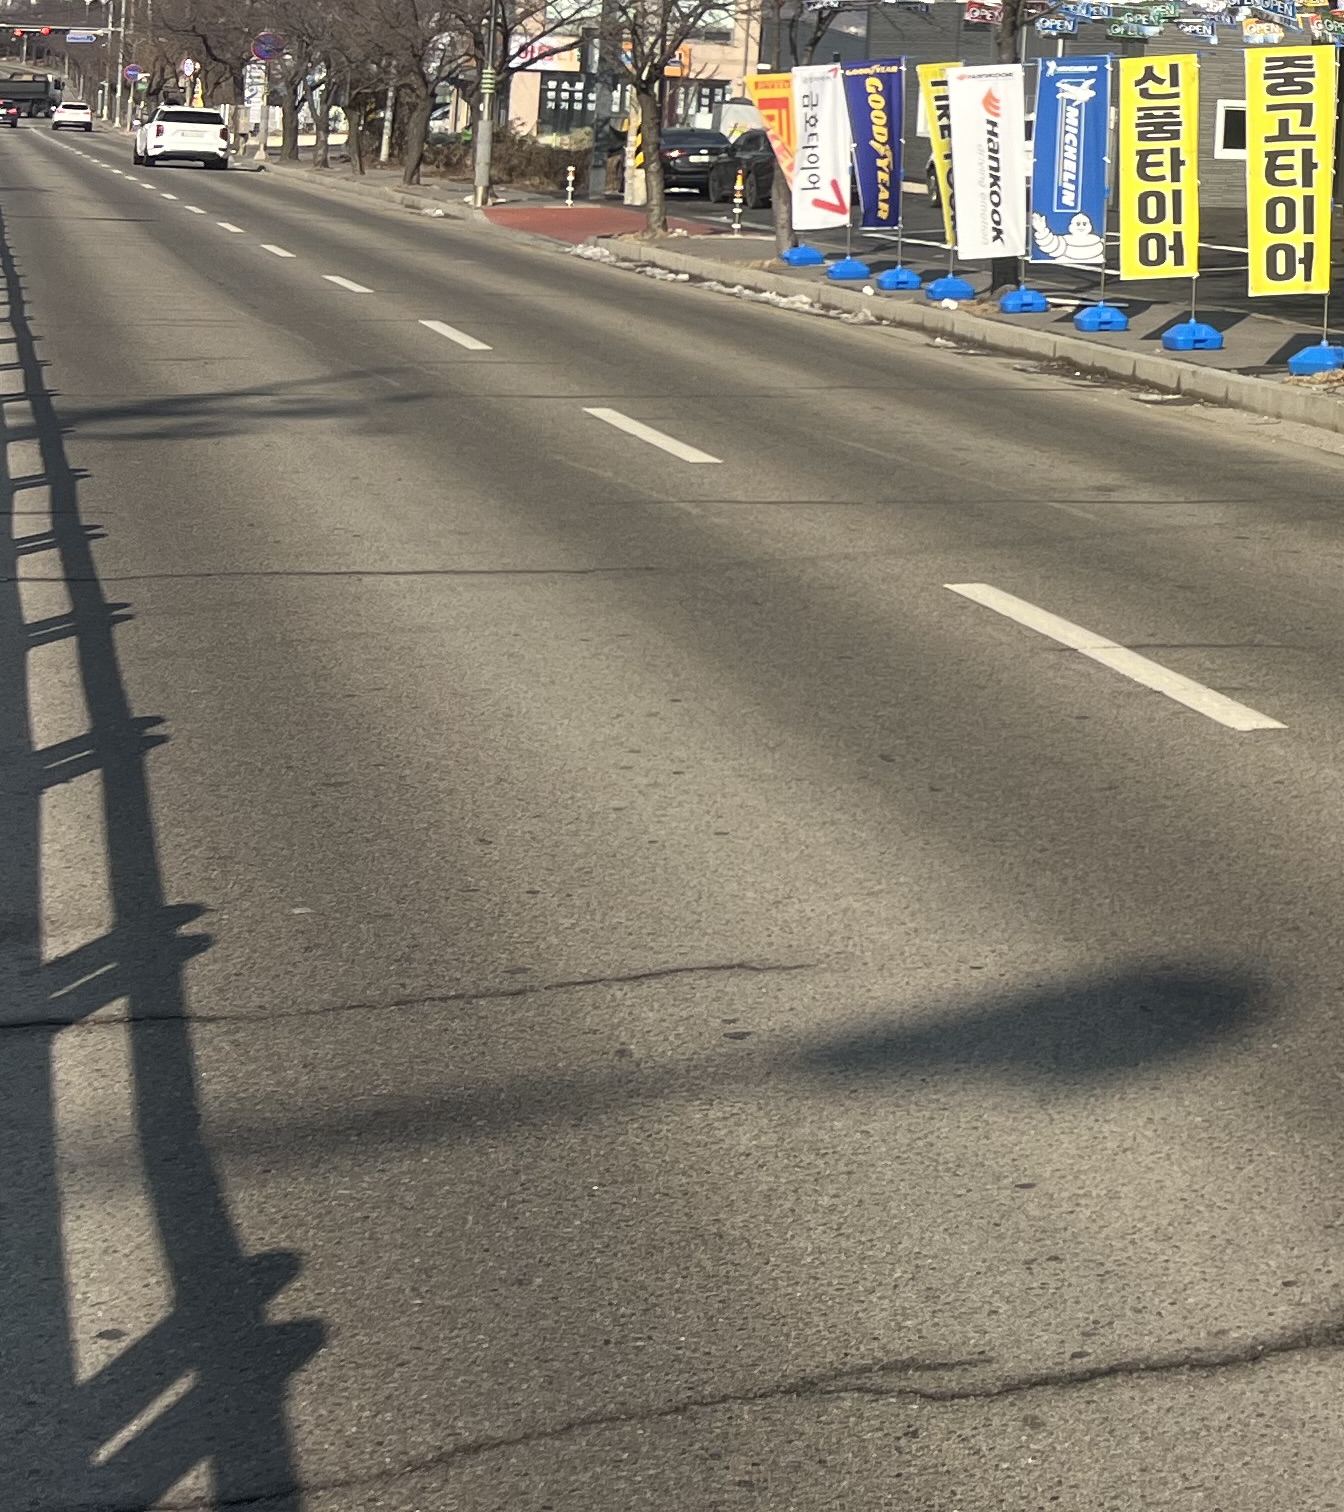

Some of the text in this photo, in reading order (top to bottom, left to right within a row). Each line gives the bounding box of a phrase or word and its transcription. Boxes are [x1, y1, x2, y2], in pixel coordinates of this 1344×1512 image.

[1039, 17, 1074, 31] OPEN
[1061, 105, 1080, 207] MICHELIN
[1134, 62, 1186, 268] 신품타이어
[1262, 54, 1318, 283] 중고타이어
